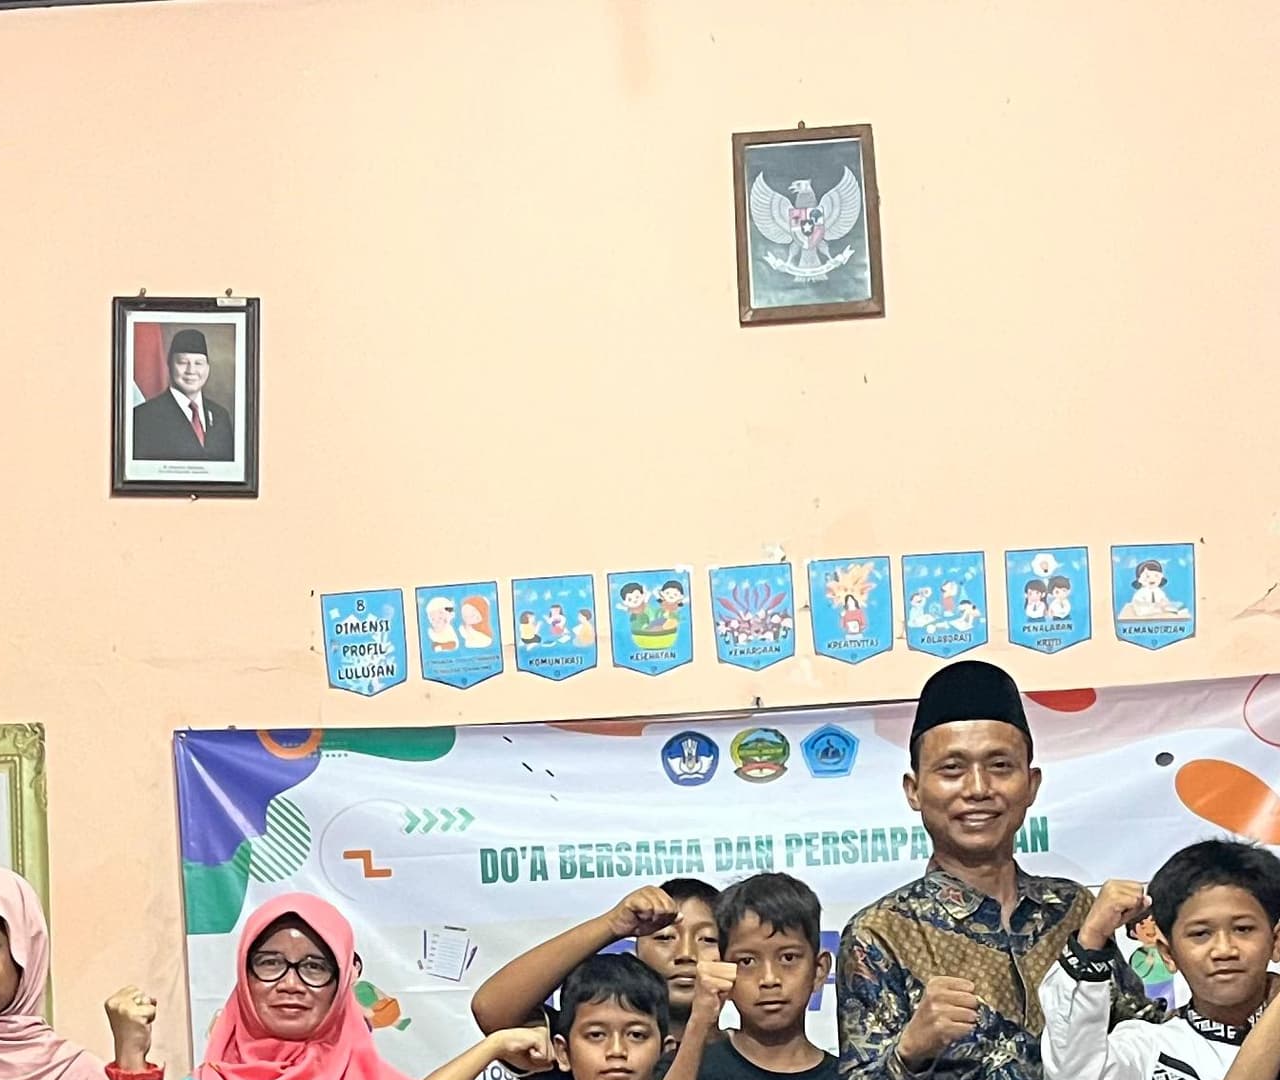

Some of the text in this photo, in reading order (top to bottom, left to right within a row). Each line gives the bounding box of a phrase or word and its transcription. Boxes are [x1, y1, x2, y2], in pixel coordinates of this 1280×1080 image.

[356, 599, 365, 612] 8
[335, 619, 390, 635] DIMENSI
[342, 642, 386, 657] PROFIL
[337, 664, 395, 680] LULUSAN
[479, 845, 549, 885] DO'A
[558, 838, 705, 881] BERSAMA
[714, 833, 774, 873] DAN
